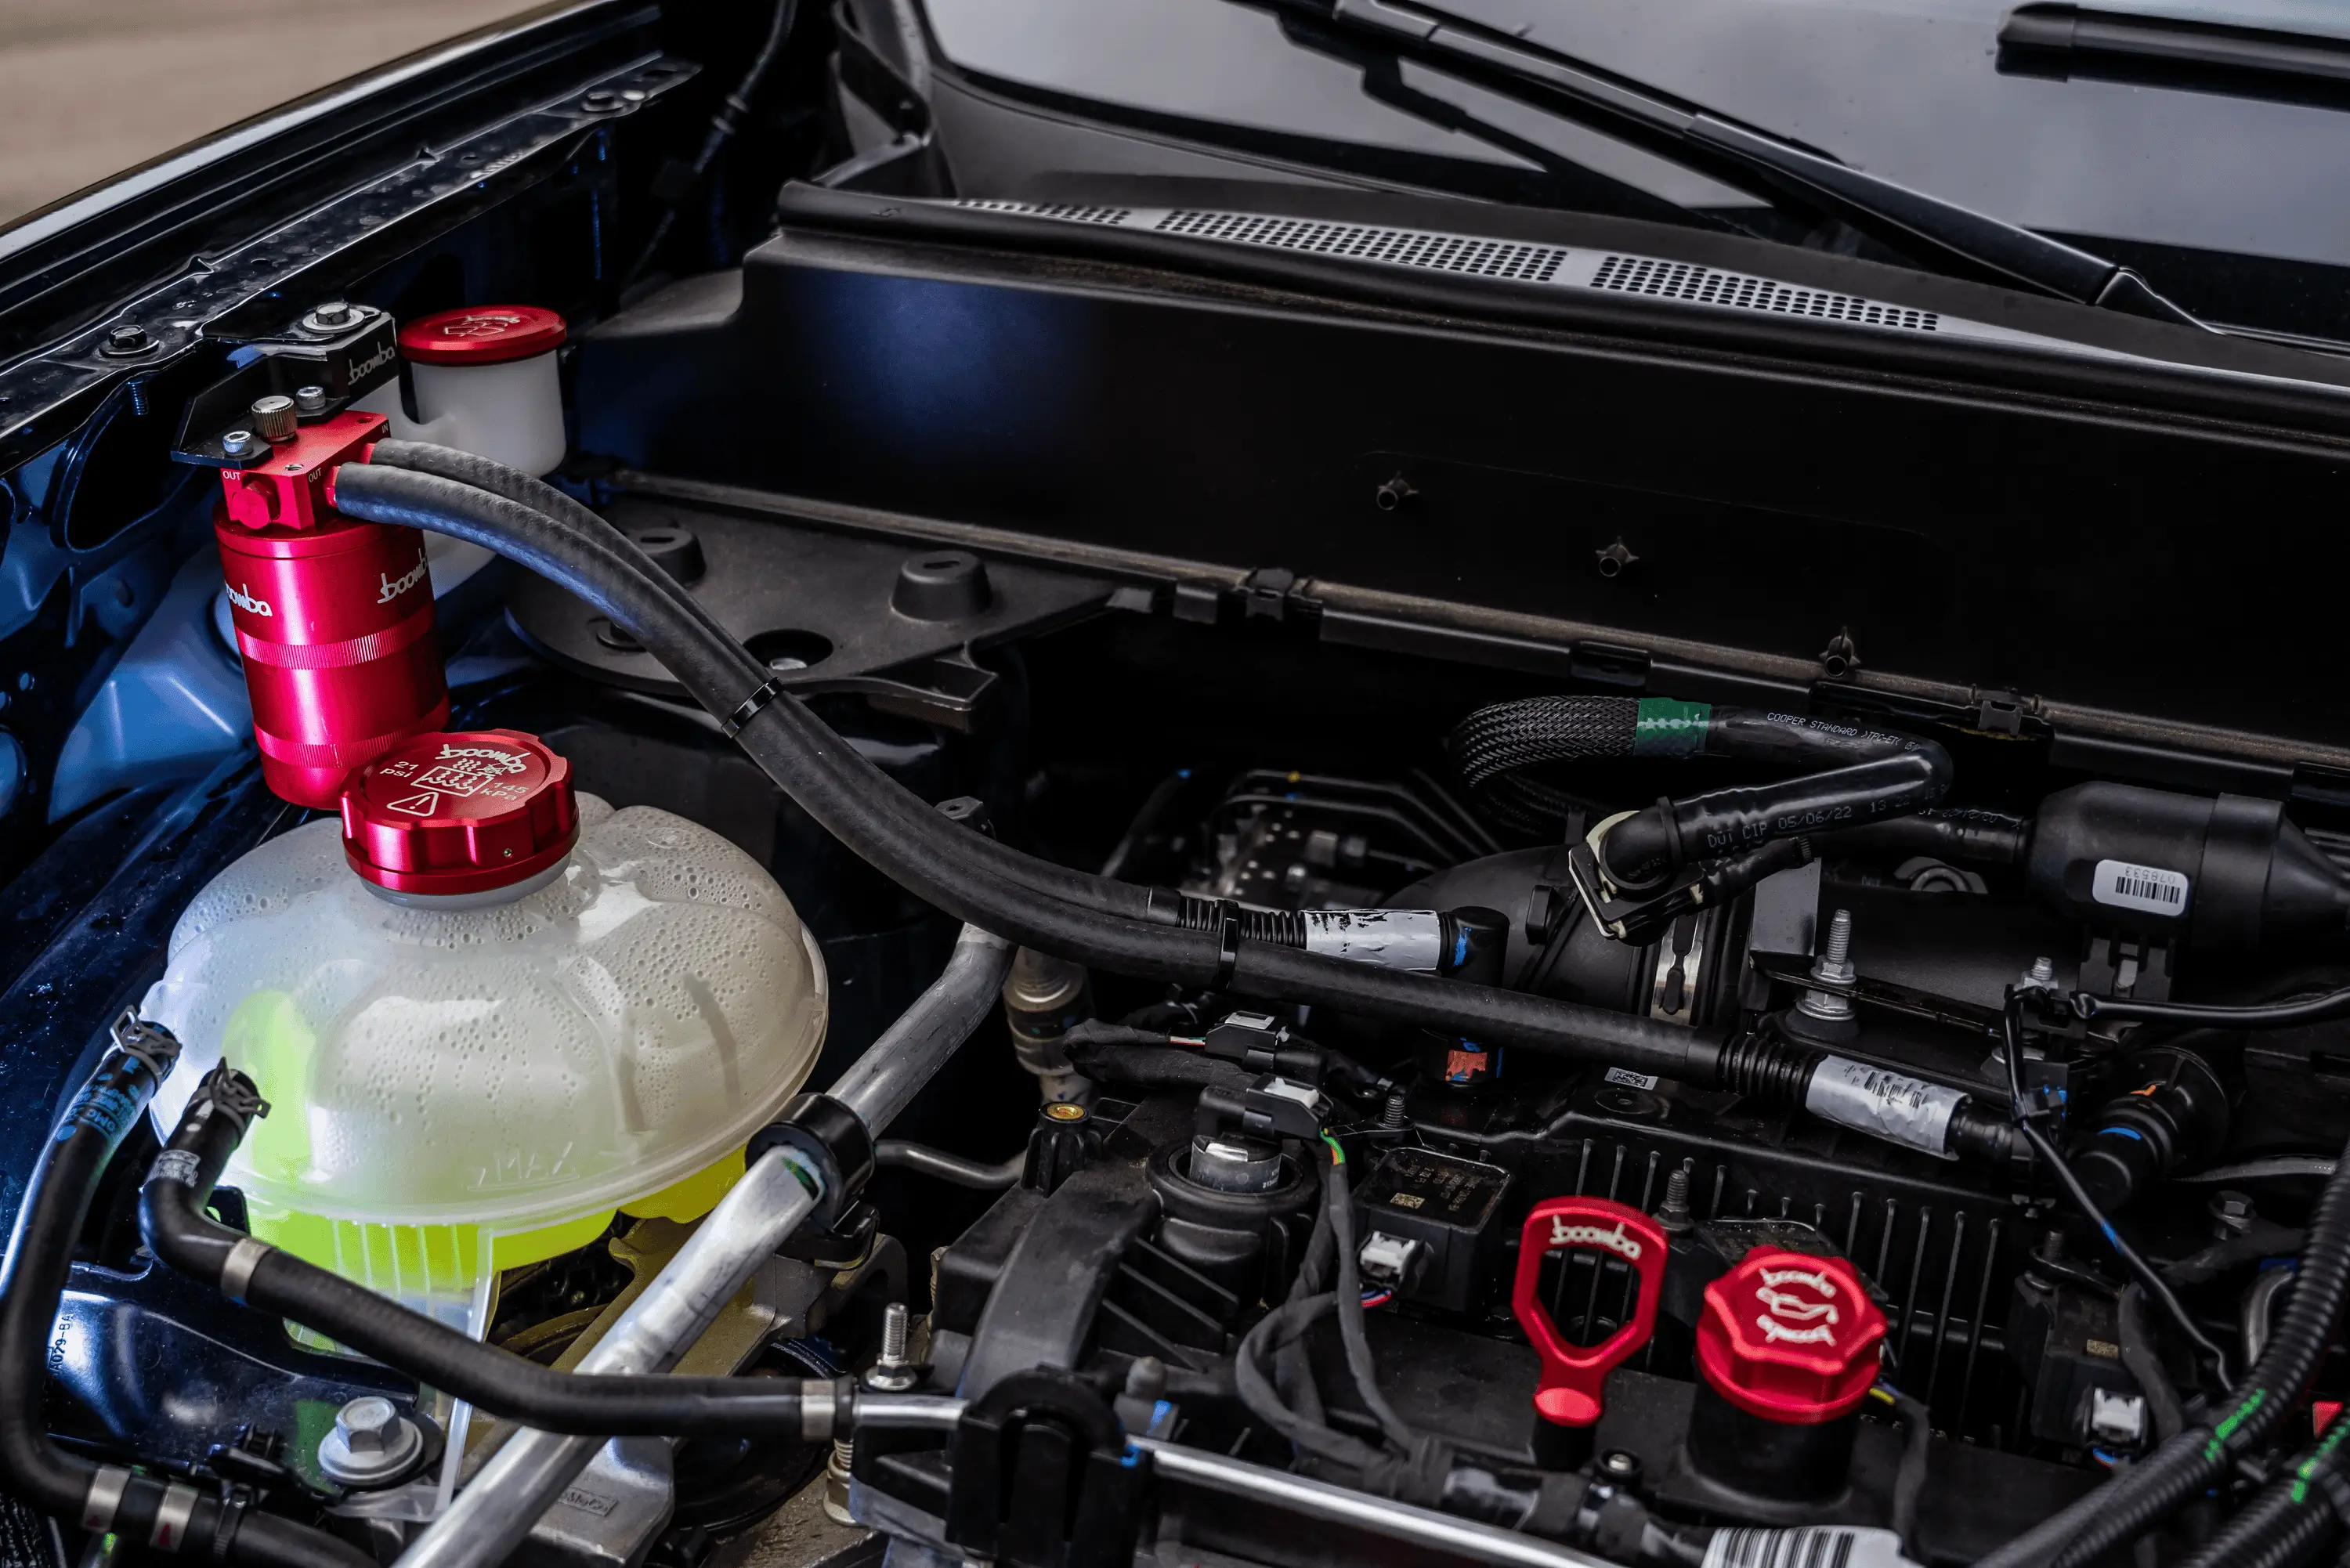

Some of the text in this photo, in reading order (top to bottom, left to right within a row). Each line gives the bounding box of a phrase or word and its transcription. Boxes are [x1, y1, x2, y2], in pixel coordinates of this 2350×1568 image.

[348, 341, 396, 386] boomba
[381, 425, 389, 434] IN
[222, 470, 240, 481] OUT
[308, 468, 322, 482] OUT
[377, 548, 428, 605] boomb
[1766, 712, 1806, 727] COOPER
[1809, 721, 1858, 737] STANDARD
[393, 761, 419, 769] 21
[435, 744, 531, 774] boomba
[379, 768, 414, 778] psi
[480, 788, 519, 801] kPa
[494, 782, 530, 793] 145
[1778, 805, 1853, 830] 05/06/22
[2124, 866, 2176, 885] 078533
[1549, 1214, 1643, 1261] boomba
